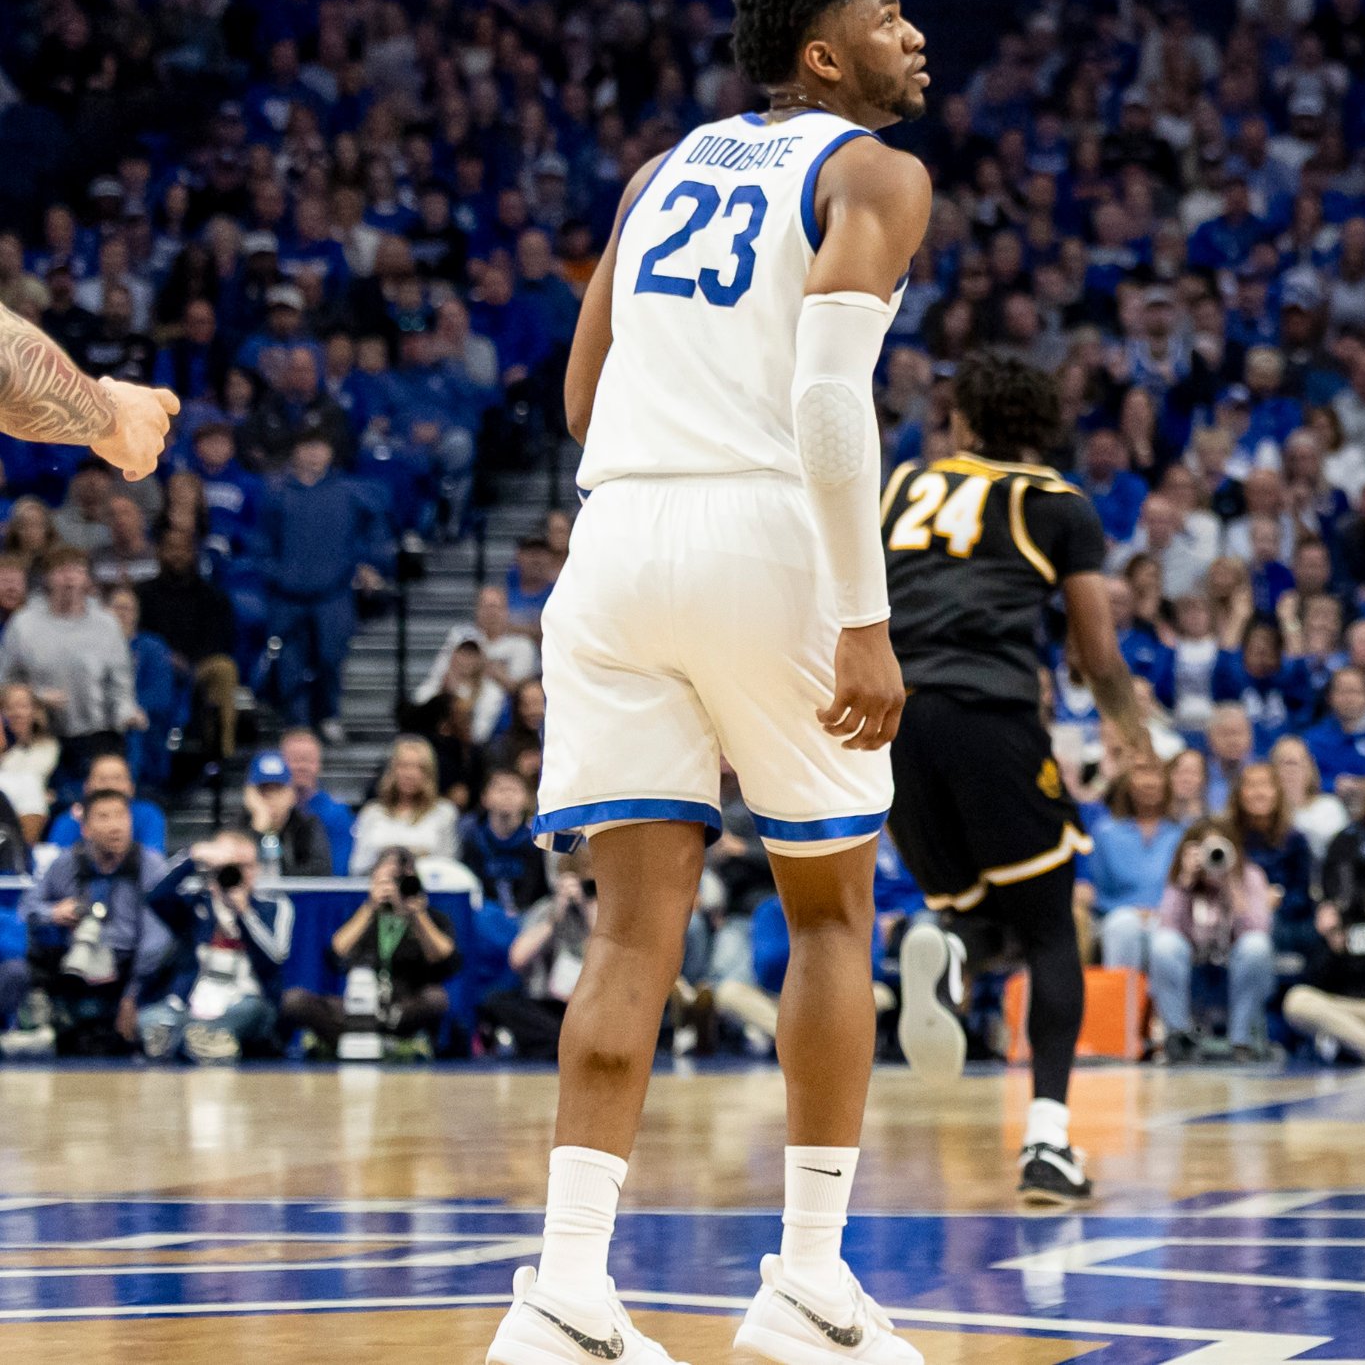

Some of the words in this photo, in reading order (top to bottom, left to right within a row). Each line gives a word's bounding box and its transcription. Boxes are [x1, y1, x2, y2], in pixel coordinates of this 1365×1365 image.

[685, 135, 803, 171] DIOUBATE
[634, 180, 768, 308] 23
[888, 471, 993, 559] 24
